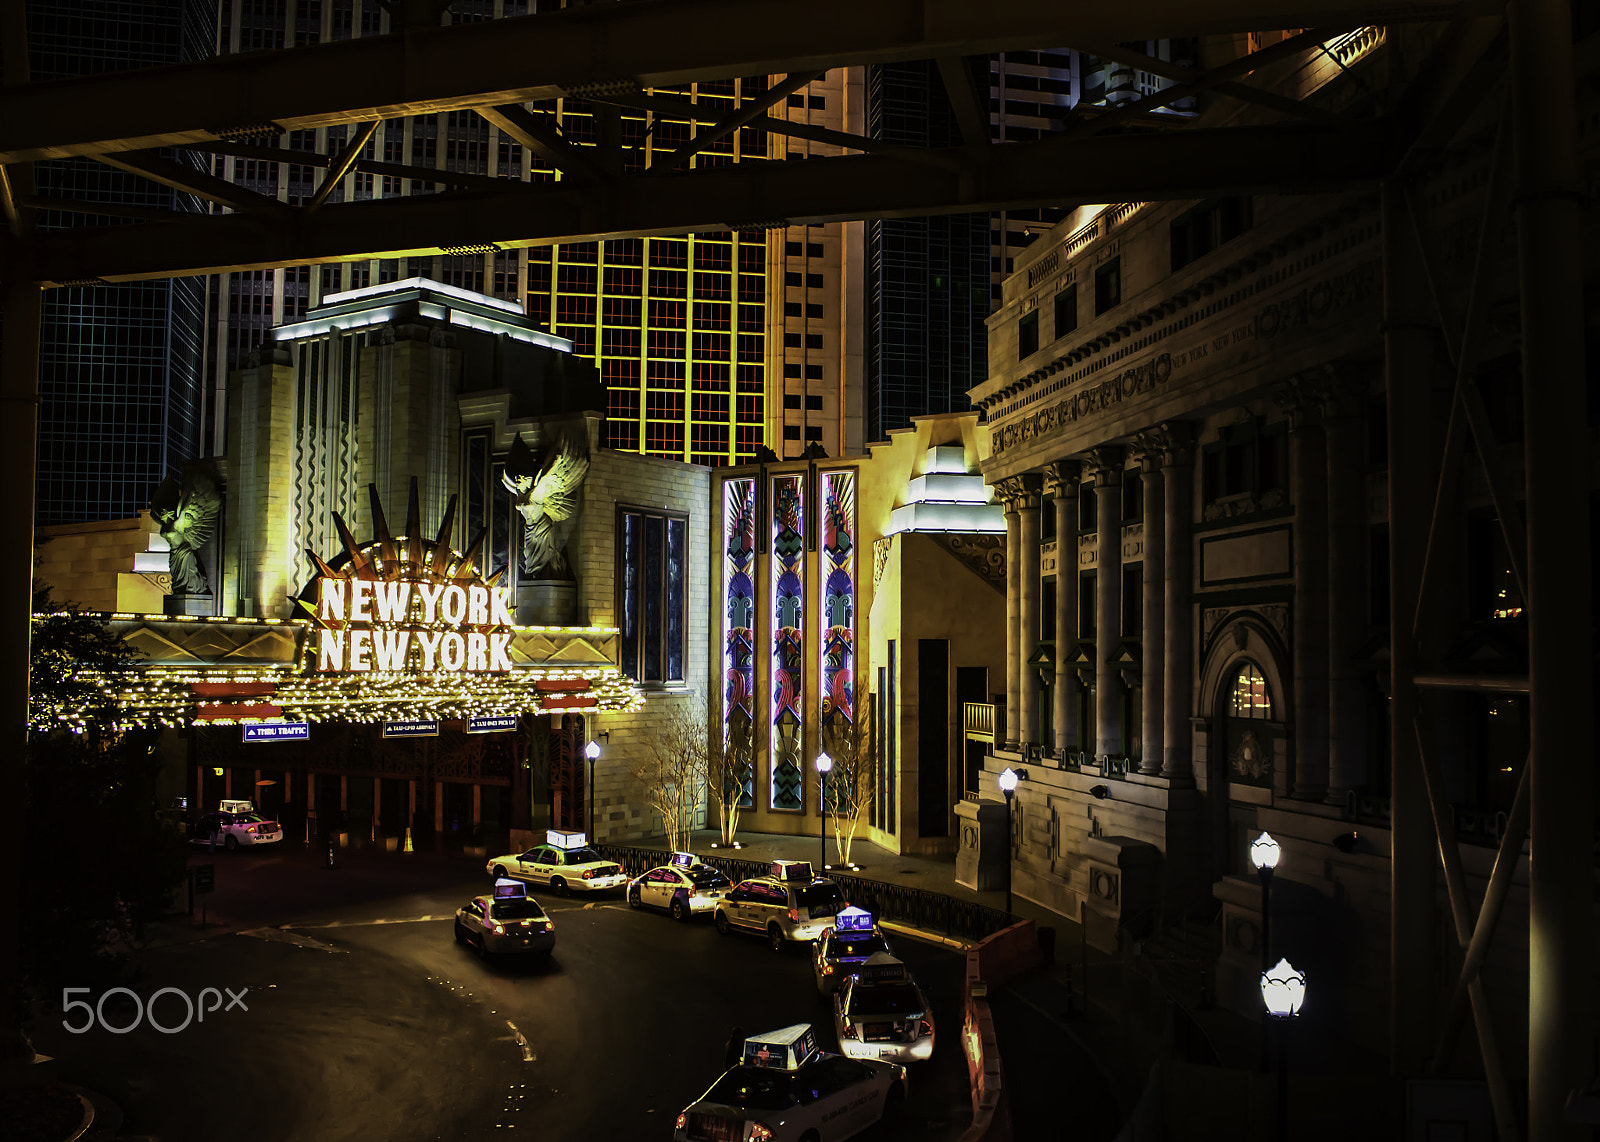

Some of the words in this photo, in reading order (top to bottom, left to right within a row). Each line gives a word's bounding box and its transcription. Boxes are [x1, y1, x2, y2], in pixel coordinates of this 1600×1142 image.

[1171, 353, 1186, 369] NEW
[1189, 343, 1208, 363] YORK
[1212, 334, 1230, 352] NEW
[1232, 324, 1253, 344] YORK
[320, 578, 411, 623] NEW
[417, 583, 514, 627] YORK
[319, 628, 410, 671] NEW
[416, 632, 513, 671] YORK
[257, 728, 277, 736] THRU
[278, 727, 306, 735] TRAFFIC
